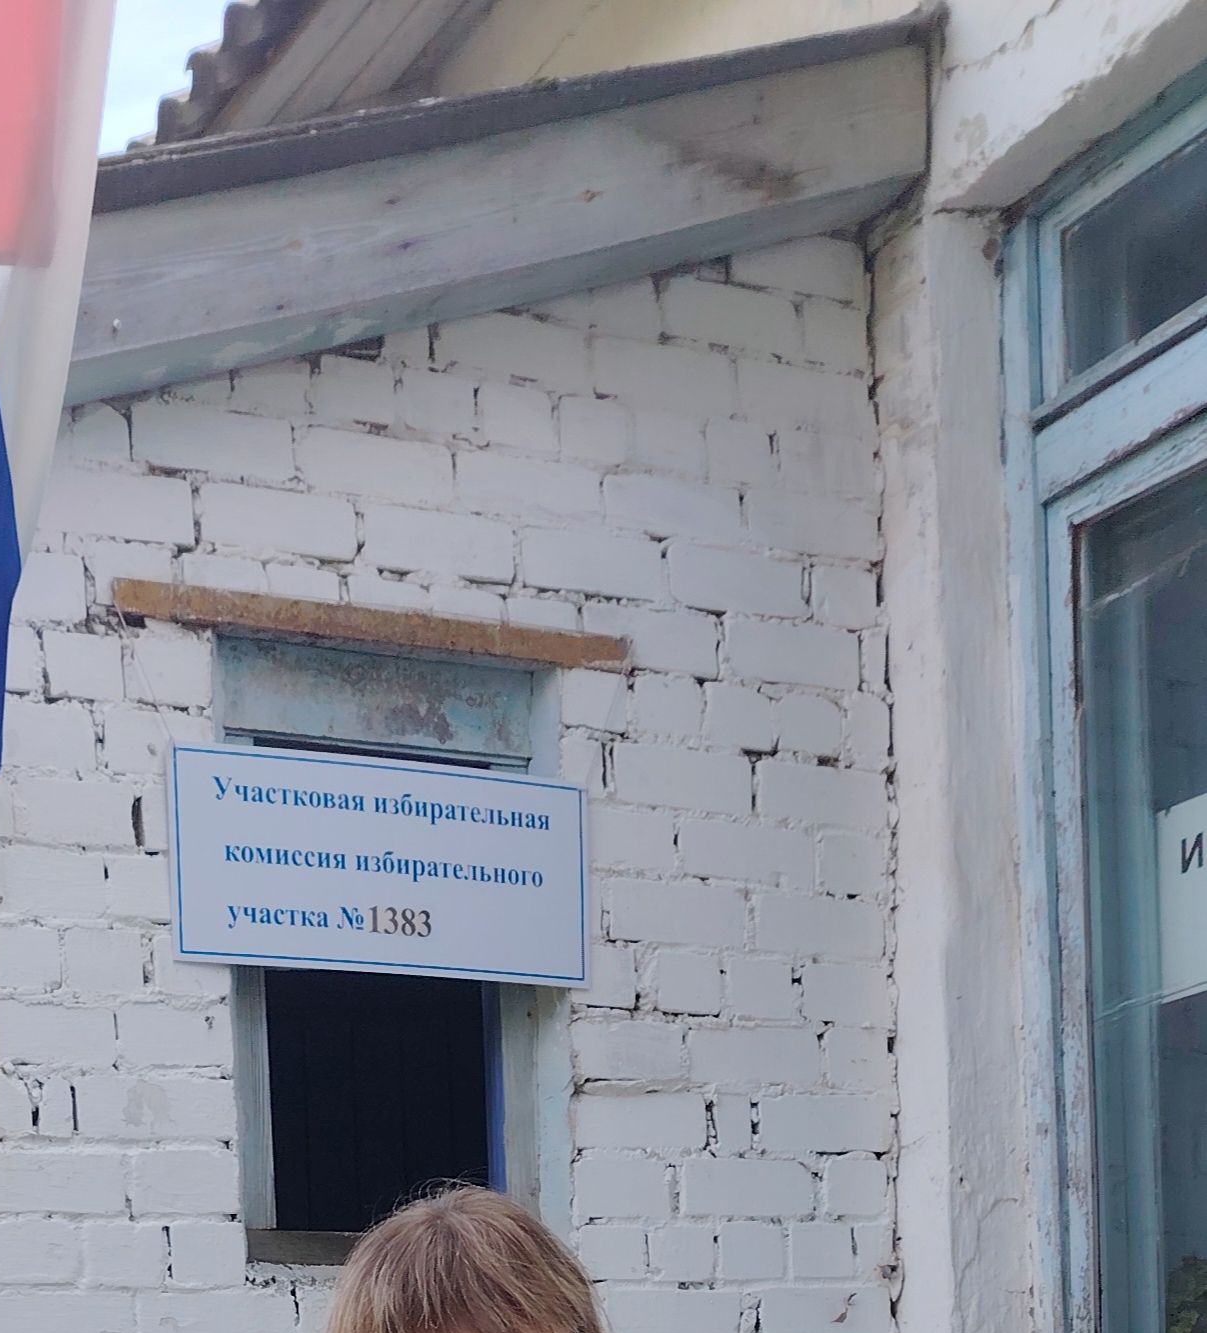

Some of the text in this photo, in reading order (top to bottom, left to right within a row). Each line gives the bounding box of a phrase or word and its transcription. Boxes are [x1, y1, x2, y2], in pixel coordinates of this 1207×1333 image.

[212, 775, 551, 831] Участковая избирательная
[224, 843, 544, 888] комиссия избирательного
[226, 904, 433, 938] участка №1383
